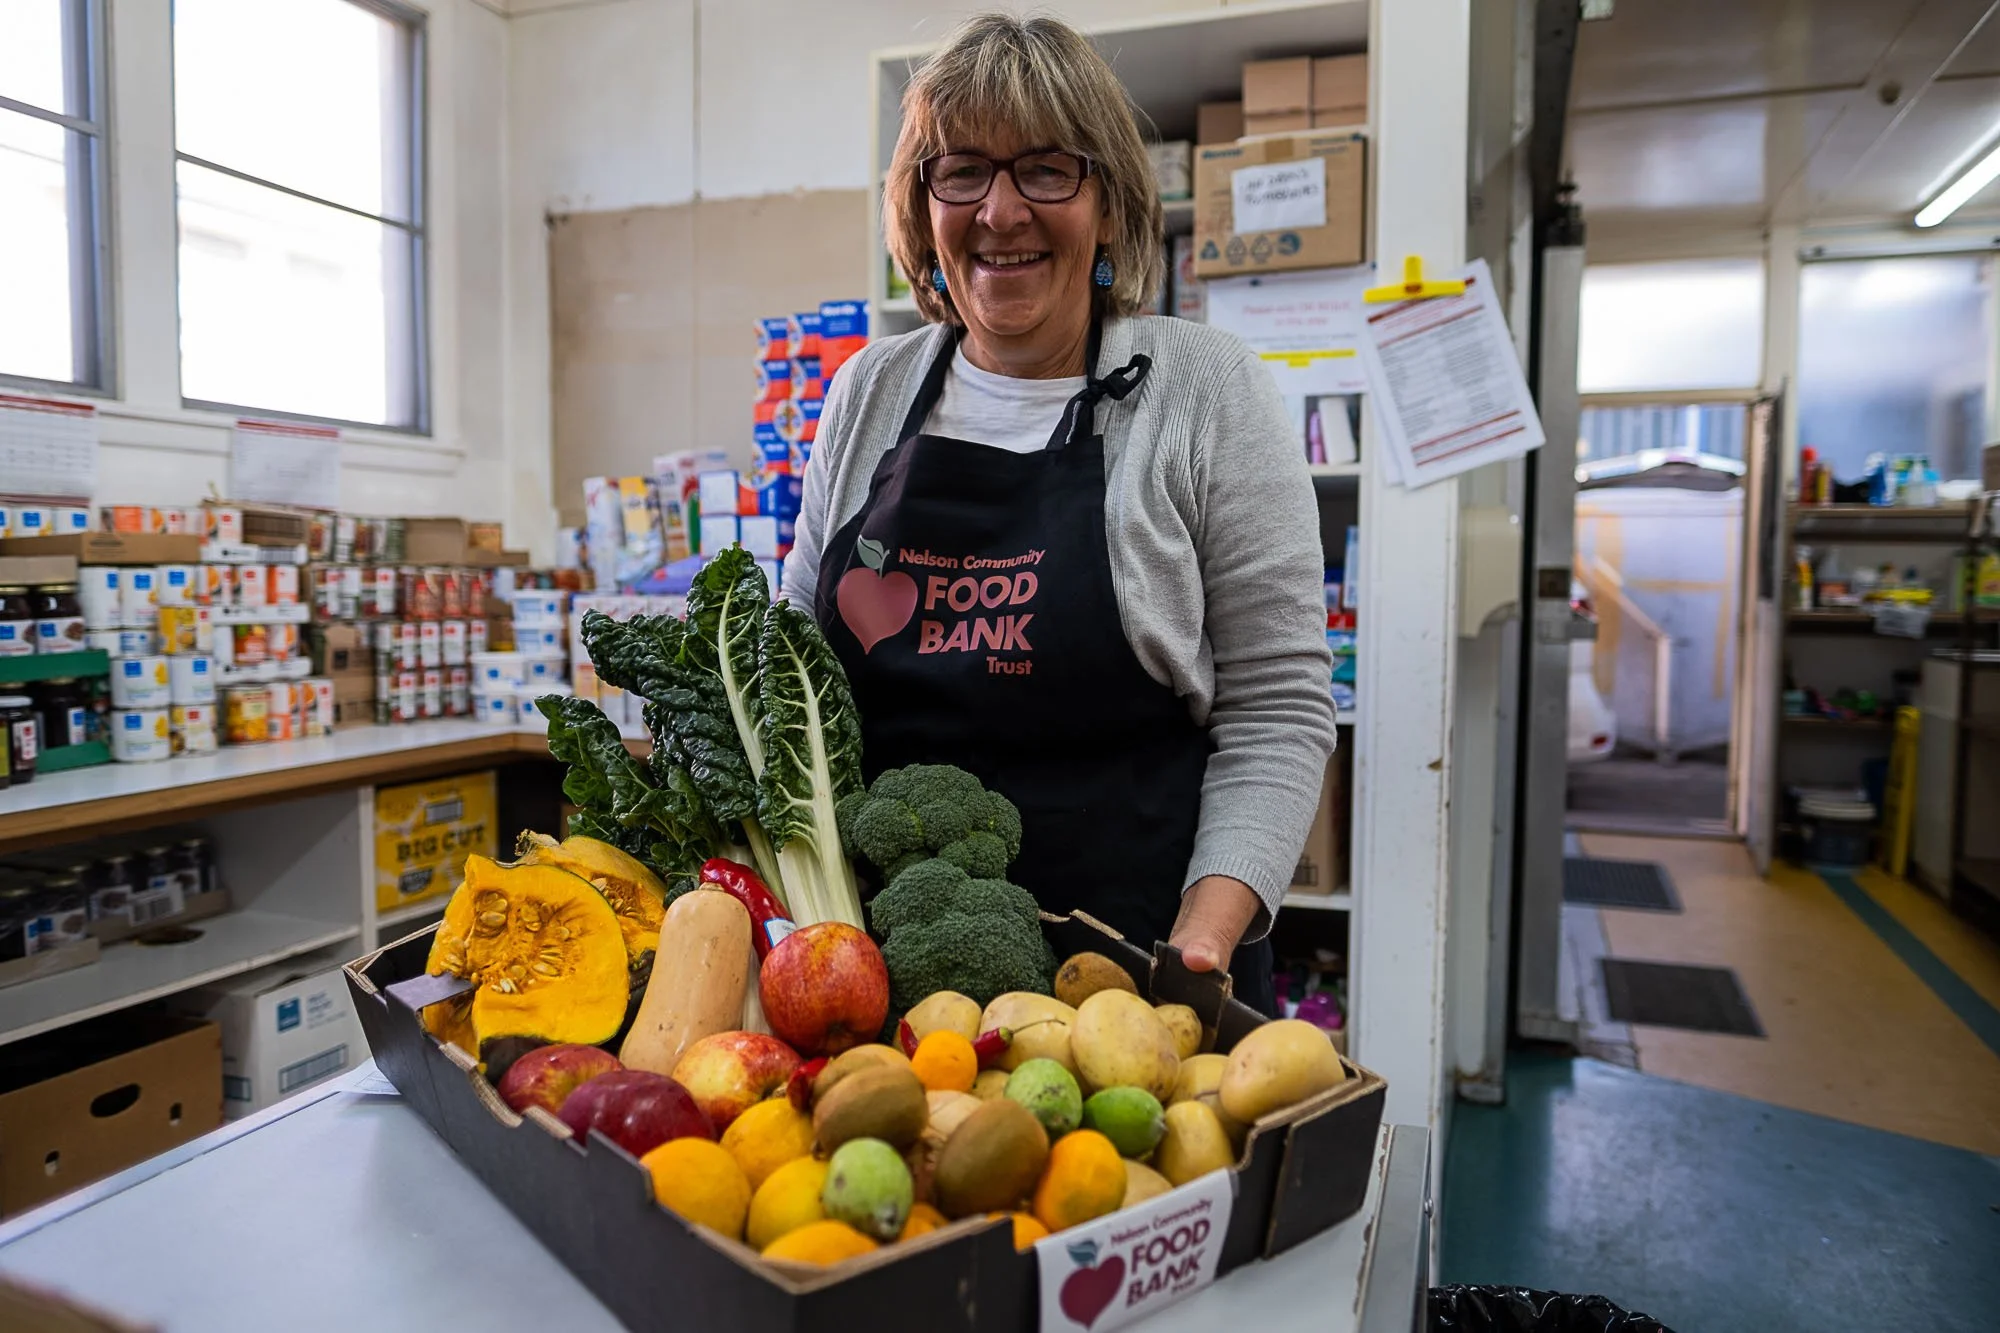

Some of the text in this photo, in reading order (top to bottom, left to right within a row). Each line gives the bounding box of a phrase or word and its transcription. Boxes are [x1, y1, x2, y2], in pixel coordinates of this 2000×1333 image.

[899, 547, 1046, 570] Nelson Community
[924, 571, 1038, 612] FOOD
[918, 613, 1035, 654] BANK
[986, 656, 1033, 675] Trust
[397, 824, 485, 863] BIG CUT
[1110, 1198, 1213, 1247] Nelson Community
[1131, 1219, 1211, 1275] FOOD
[1126, 1248, 1206, 1308] BANK
